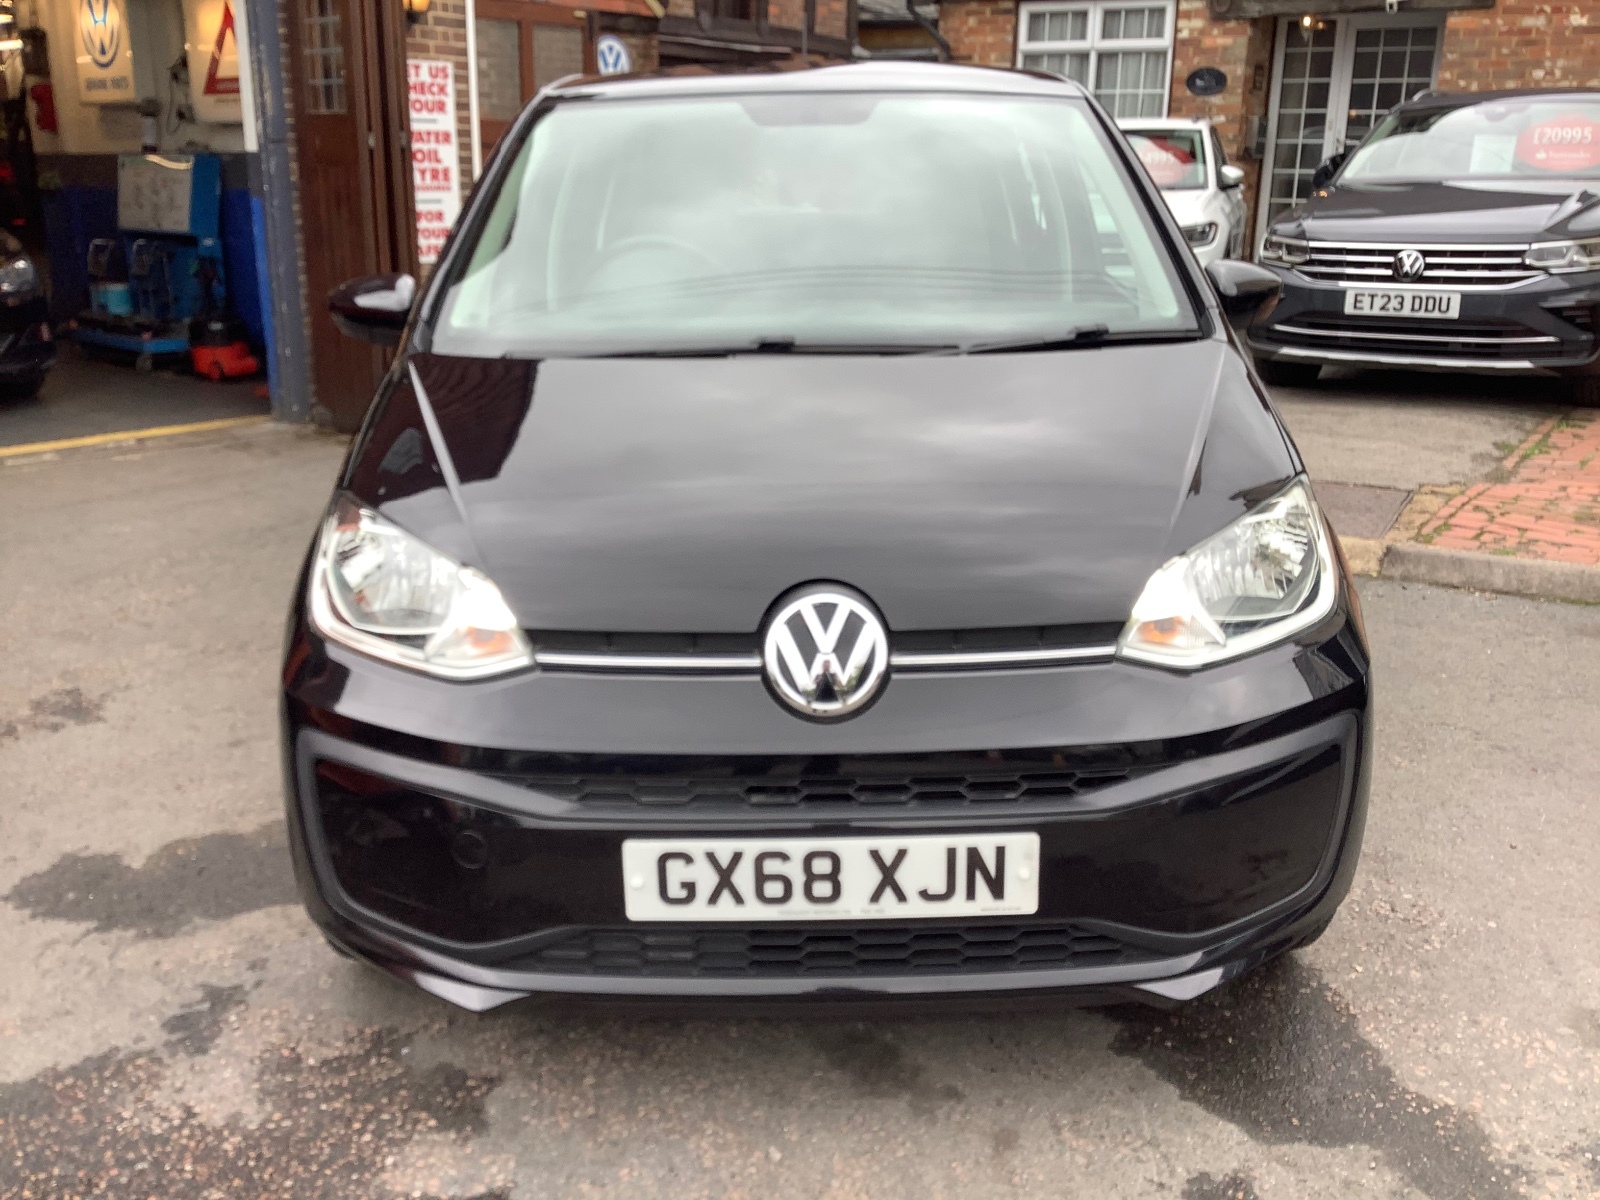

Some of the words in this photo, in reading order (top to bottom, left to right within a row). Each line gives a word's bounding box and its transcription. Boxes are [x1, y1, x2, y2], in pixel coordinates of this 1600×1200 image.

[429, 66, 449, 79] US
[408, 100, 447, 113] OUR
[411, 131, 452, 144] ATER
[412, 149, 441, 163] OIL
[416, 210, 444, 222] FOR
[416, 228, 451, 240] OUR
[1353, 293, 1405, 312] ET23
[1410, 295, 1452, 314] DDU
[656, 850, 842, 906] GX68
[868, 845, 1007, 905] XJN
